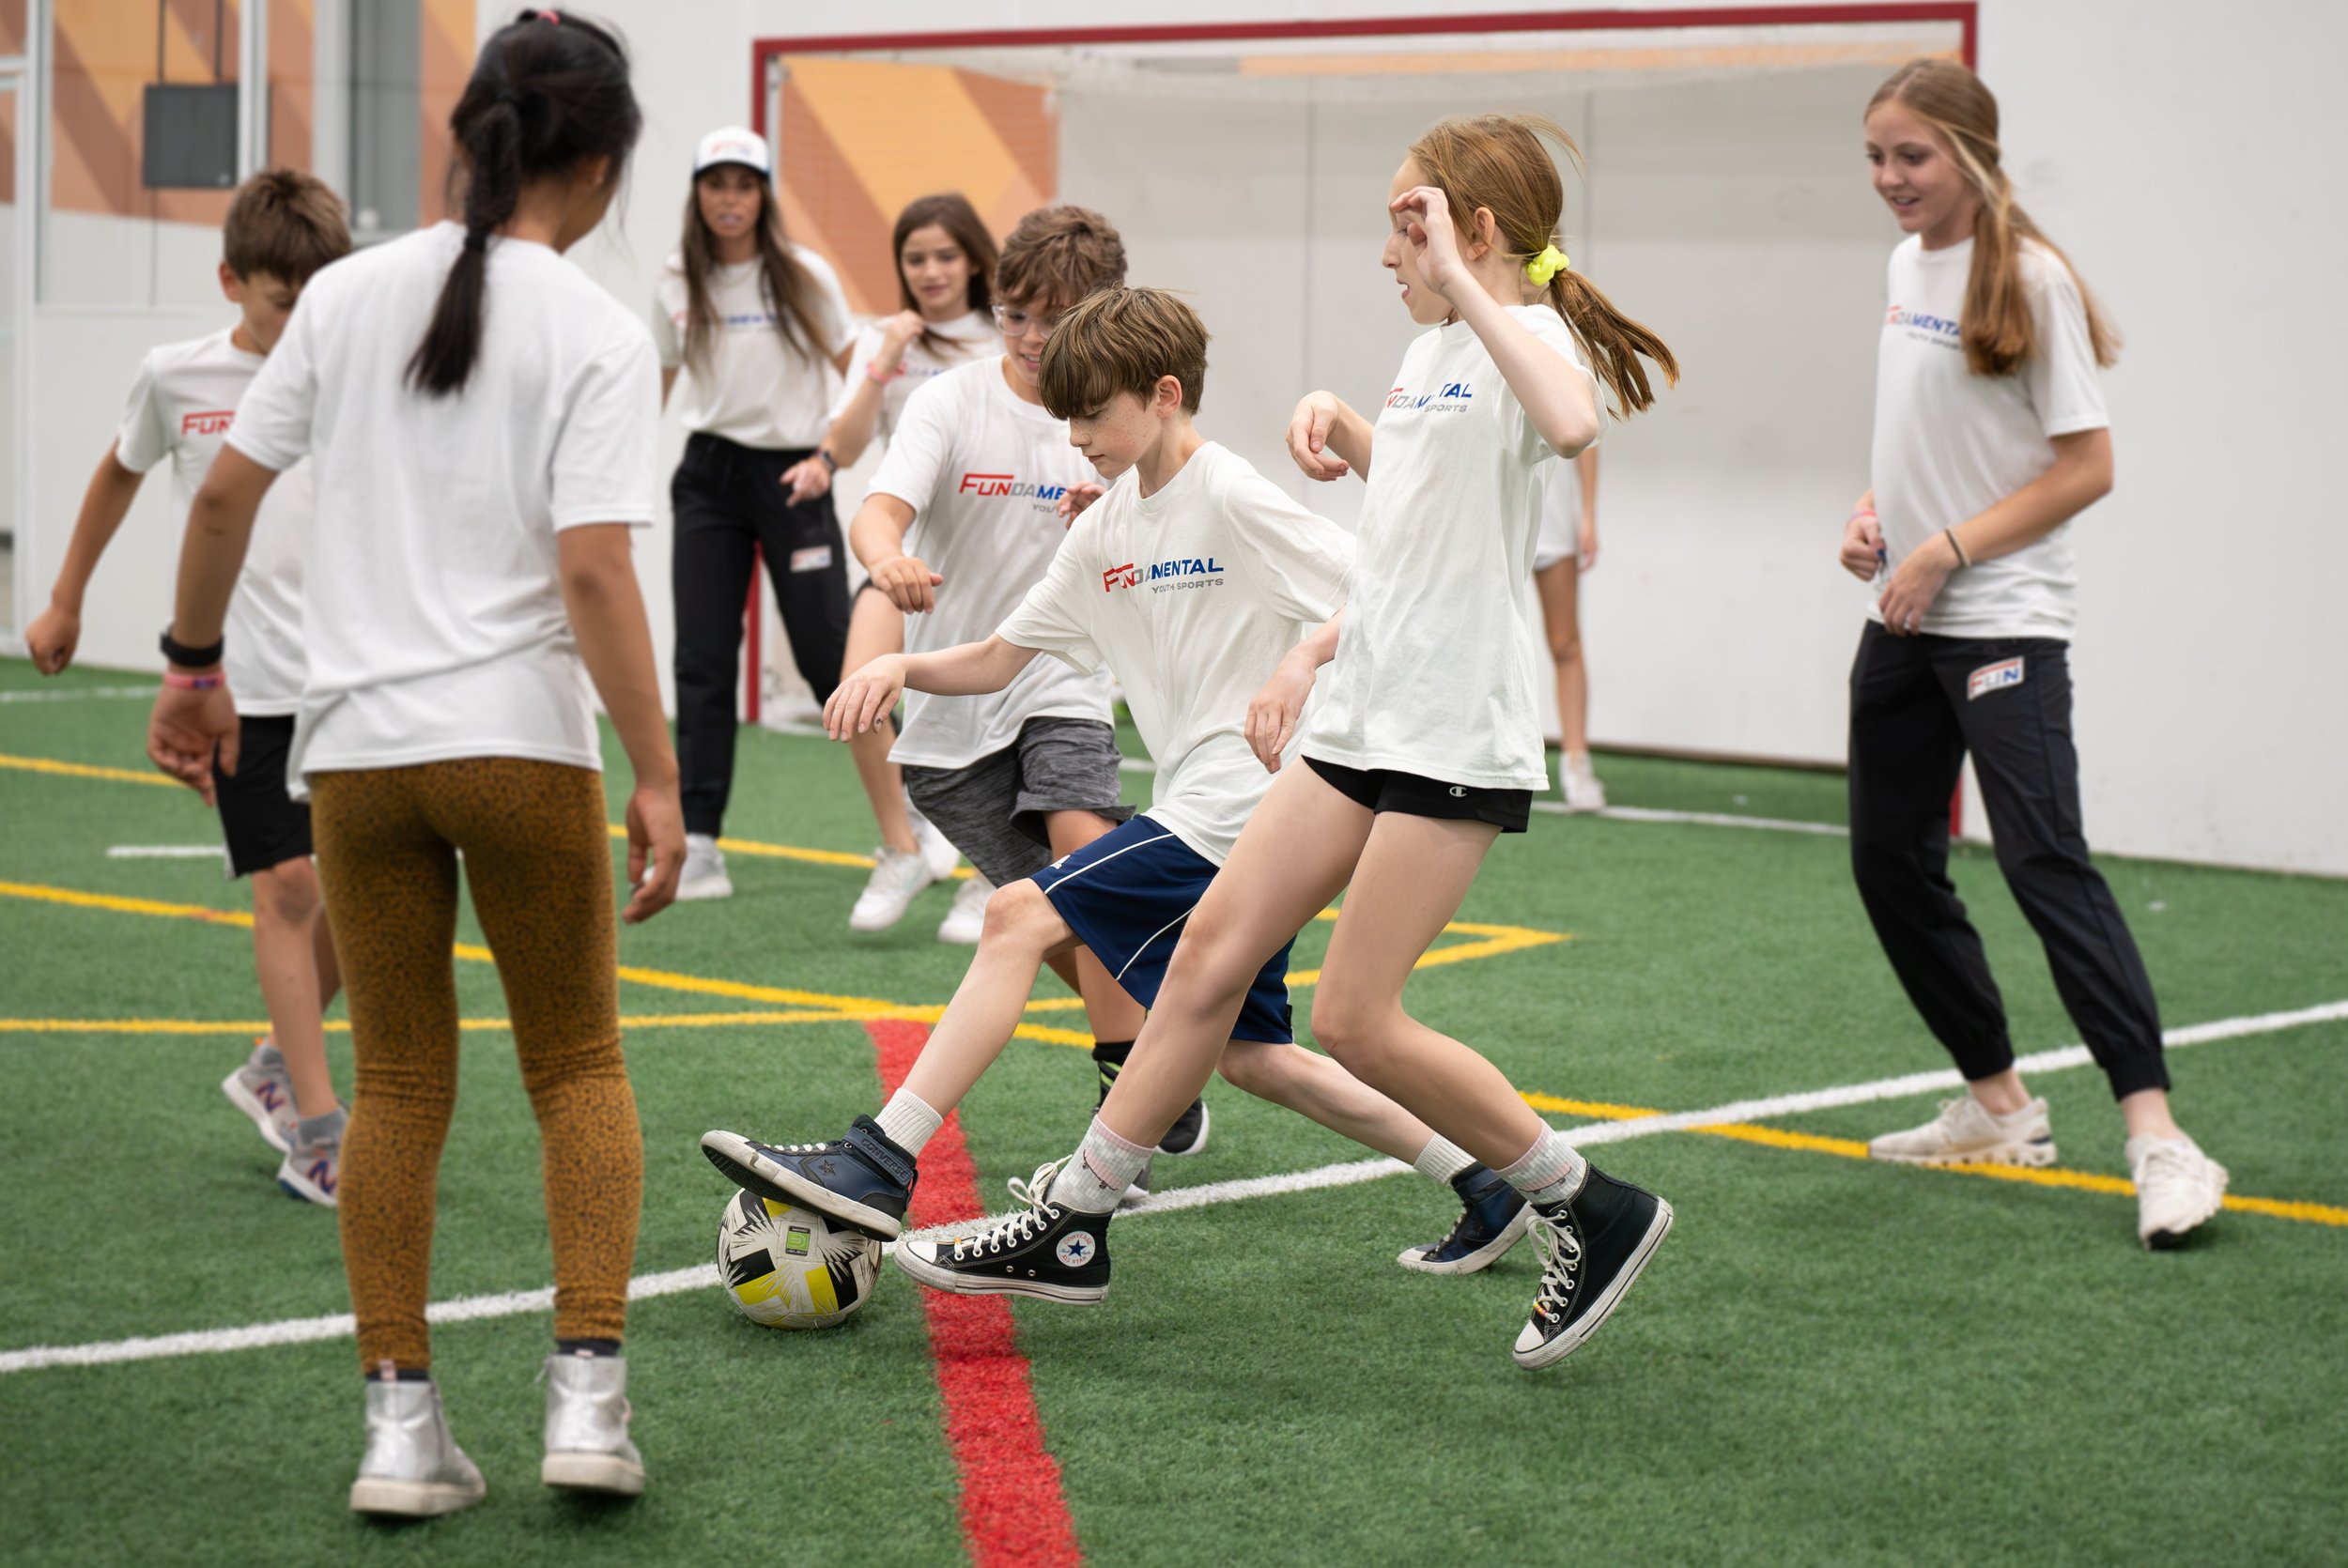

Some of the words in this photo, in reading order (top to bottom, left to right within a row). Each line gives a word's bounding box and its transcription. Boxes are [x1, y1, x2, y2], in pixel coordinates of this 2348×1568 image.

[1424, 404, 1468, 413] SPORTS
[1032, 502, 1058, 514] YOU
[1151, 583, 1175, 594] YOUTH
[1177, 577, 1225, 592] SPORTS
[1970, 660, 2019, 694] FUN
[861, 1138, 908, 1179] CONVERSE
[1063, 1234, 1092, 1245] CONVERSE
